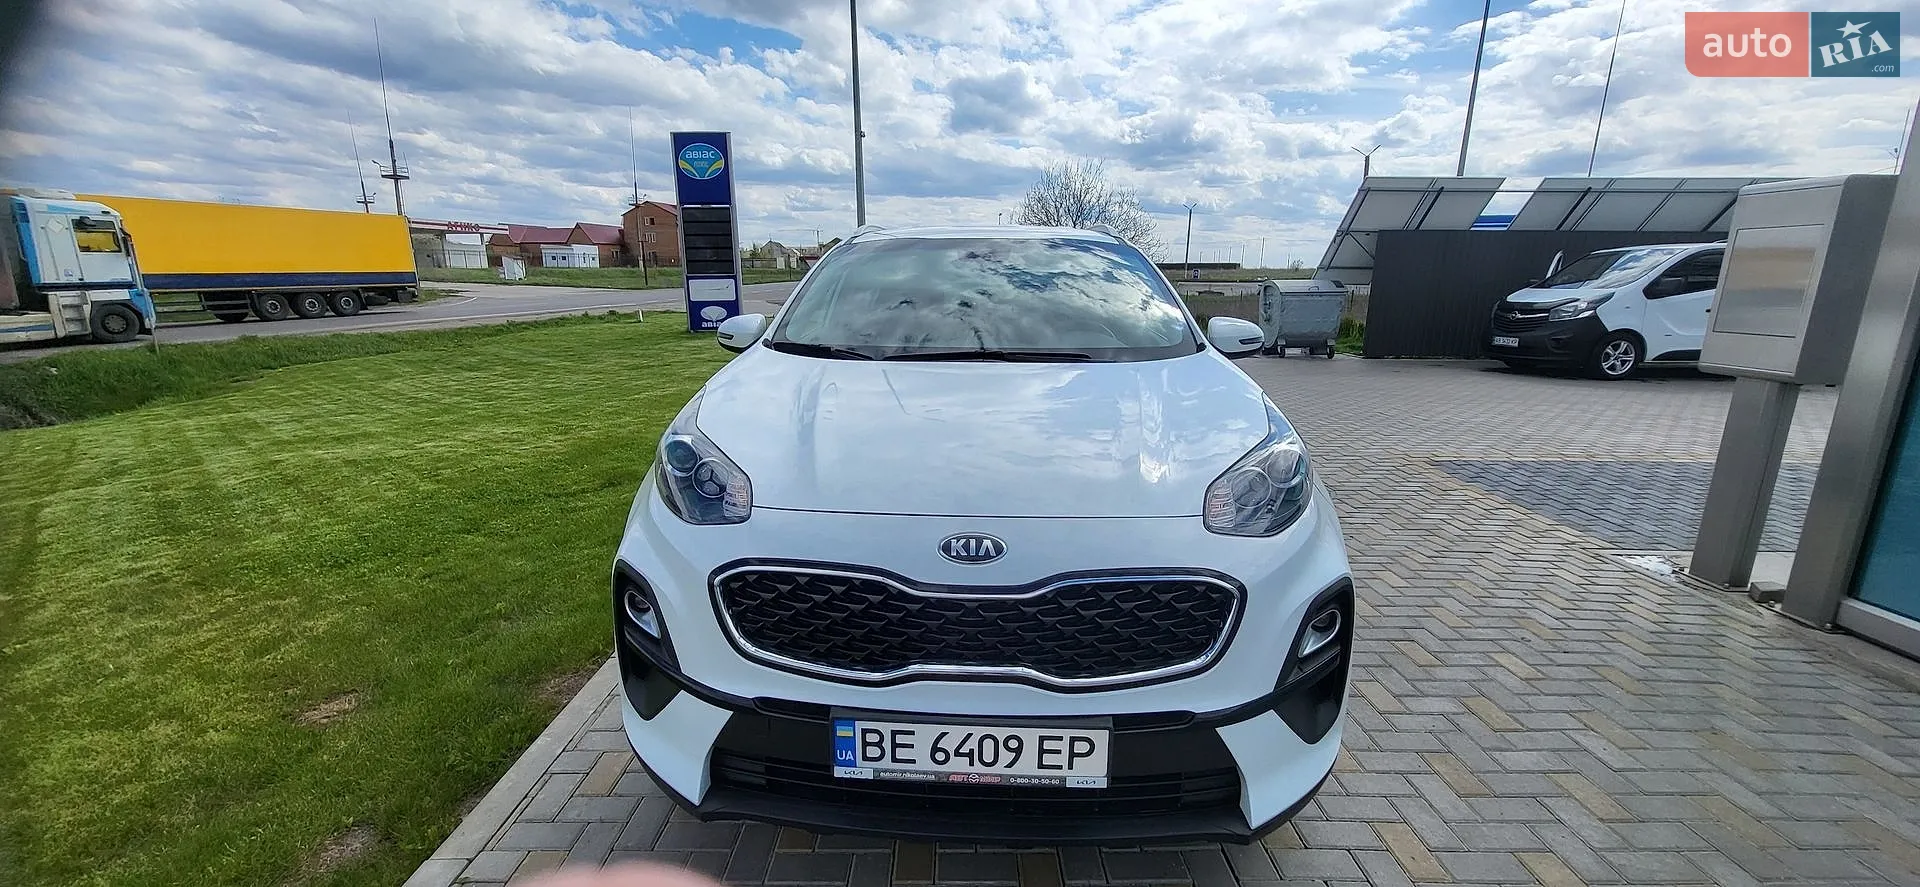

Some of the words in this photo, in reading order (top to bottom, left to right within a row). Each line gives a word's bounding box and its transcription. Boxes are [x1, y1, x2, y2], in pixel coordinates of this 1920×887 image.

[950, 538, 997, 557] KIA
[837, 750, 855, 761] UA
[860, 727, 917, 765] BE
[929, 731, 1024, 769] 6409
[1037, 735, 1096, 771] EP
